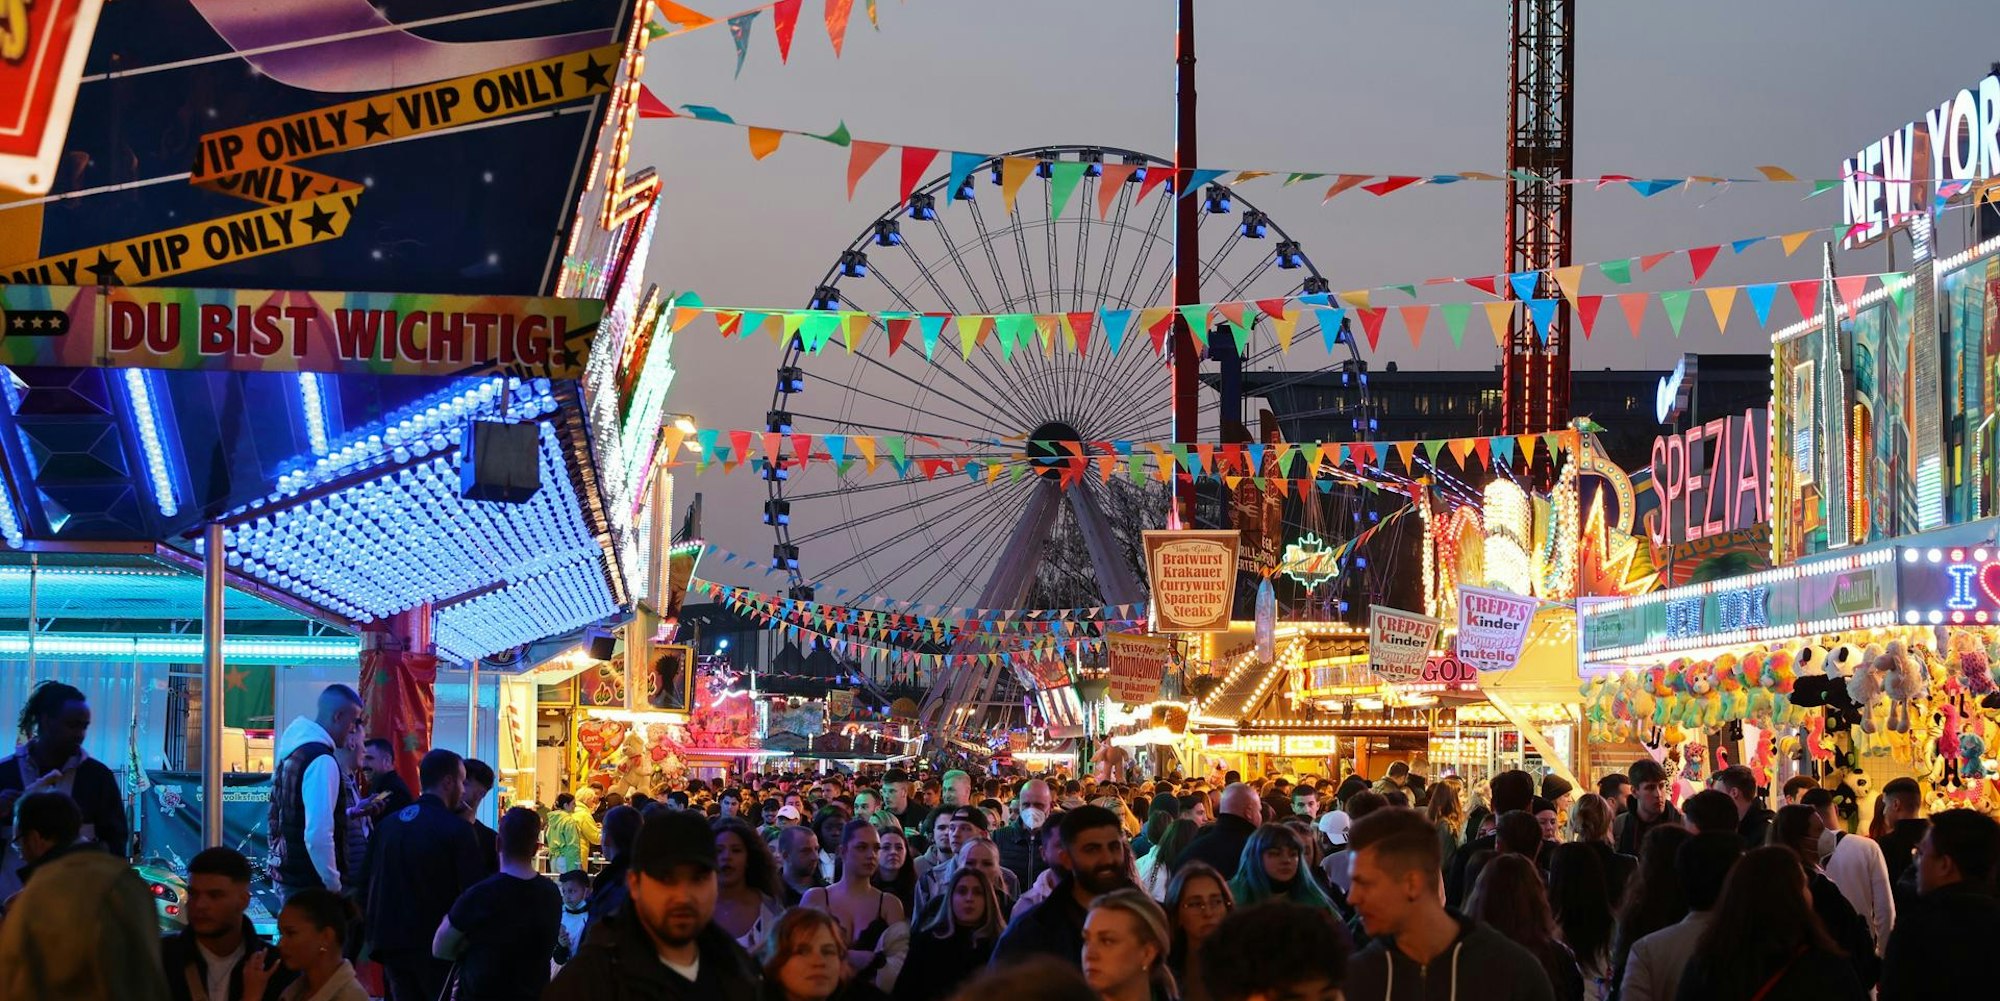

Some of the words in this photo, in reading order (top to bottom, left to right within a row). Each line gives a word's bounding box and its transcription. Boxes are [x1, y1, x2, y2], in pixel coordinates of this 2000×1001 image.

[190, 134, 243, 178] VIP
[257, 109, 347, 162] ONLY
[396, 87, 460, 130] VIP
[473, 62, 564, 114] ONLY
[1843, 121, 1914, 250] NEW
[128, 234, 190, 277] VIP
[203, 209, 293, 261] ONLY
[109, 301, 181, 353] DU
[199, 304, 318, 358] BIST
[334, 308, 567, 367] WICHTIG!
[1650, 401, 1773, 547] SPEZIA
[1162, 553, 1222, 565] Bratwurst
[1163, 566, 1222, 578] Krakauer
[1160, 579, 1226, 592] Currywurst
[1948, 564, 1977, 608] I
[1164, 592, 1222, 605] Spareribs
[1173, 605, 1212, 617] Steaks
[1666, 597, 1705, 639] NEW
[1717, 586, 1770, 632] YORK
[1467, 611, 1520, 630] kinder
[1121, 643, 1155, 656] Frische
[1460, 649, 1516, 662] nutella
[1371, 663, 1420, 676] nutella
